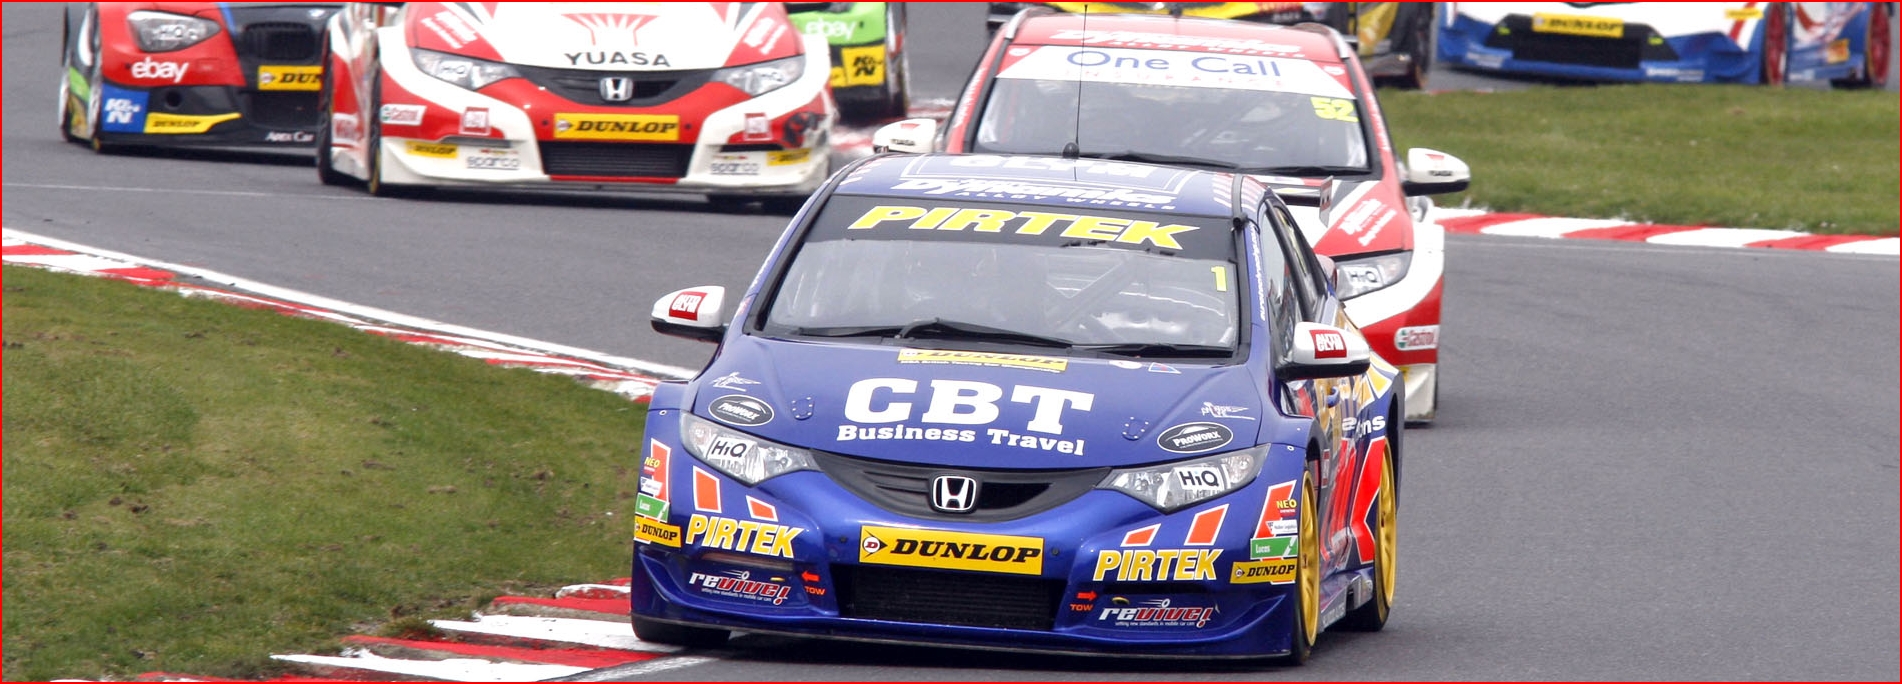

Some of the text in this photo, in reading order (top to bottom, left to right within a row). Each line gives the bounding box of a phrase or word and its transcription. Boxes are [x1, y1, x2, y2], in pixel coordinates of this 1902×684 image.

[805, 18, 857, 40] ebay
[564, 51, 671, 67] YUASA
[1066, 50, 1282, 77] One Call
[131, 56, 190, 83] ebay
[1310, 96, 1359, 123] 52
[576, 120, 678, 133] DUNLOP
[466, 156, 520, 170] sparco
[710, 163, 760, 175] sparco
[891, 178, 1177, 204] Dynamics
[956, 191, 1177, 209] ALLOY WHEELS
[847, 205, 1200, 251] PIRTEK
[1211, 265, 1228, 292] 1
[928, 351, 1066, 365] DUNLOP
[844, 377, 1095, 435] CBT
[711, 440, 747, 458] HiQ
[836, 424, 1085, 456] Business Travel
[644, 456, 661, 468] NEO
[1179, 470, 1220, 487] HiQ
[1276, 499, 1298, 509] NEO
[642, 524, 678, 541] DUNLOP
[685, 513, 804, 559] PIRTEK
[890, 538, 1042, 564] DUNLOP
[1092, 547, 1225, 582] PIRTEK
[1246, 564, 1295, 577] DUNLOP
[689, 570, 791, 605] revive!
[805, 586, 826, 596] TOW
[1070, 603, 1094, 611] TOW
[1098, 598, 1214, 628] revive!
